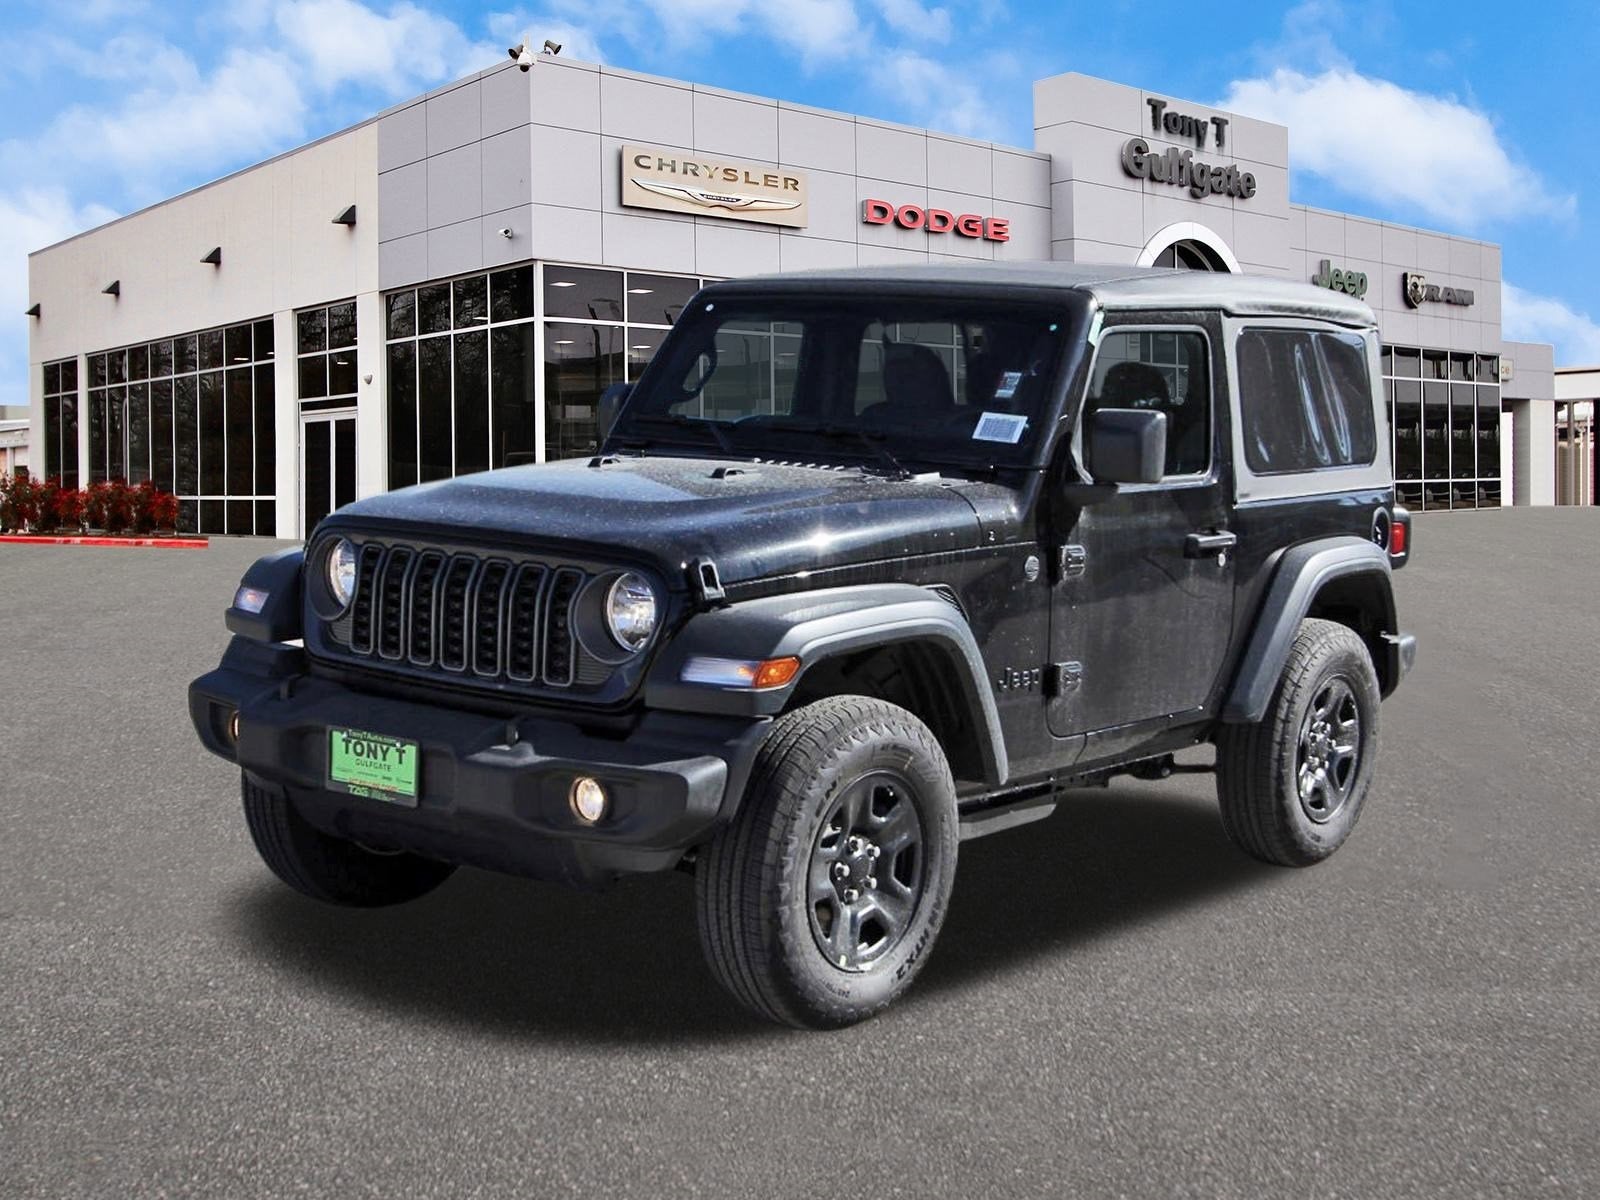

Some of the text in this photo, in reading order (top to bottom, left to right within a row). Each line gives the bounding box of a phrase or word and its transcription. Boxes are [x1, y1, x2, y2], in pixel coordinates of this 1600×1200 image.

[1147, 98, 1229, 147] Tony T
[633, 154, 800, 192] CHRYSLER
[1121, 138, 1257, 199] Gulfgate
[862, 199, 1010, 242] DODGE
[1312, 259, 1368, 301] Jeep
[1425, 284, 1475, 307] RAM
[997, 666, 1040, 692] Jeep
[342, 737, 406, 764] TONY T
[355, 758, 392, 773] GULFGATE
